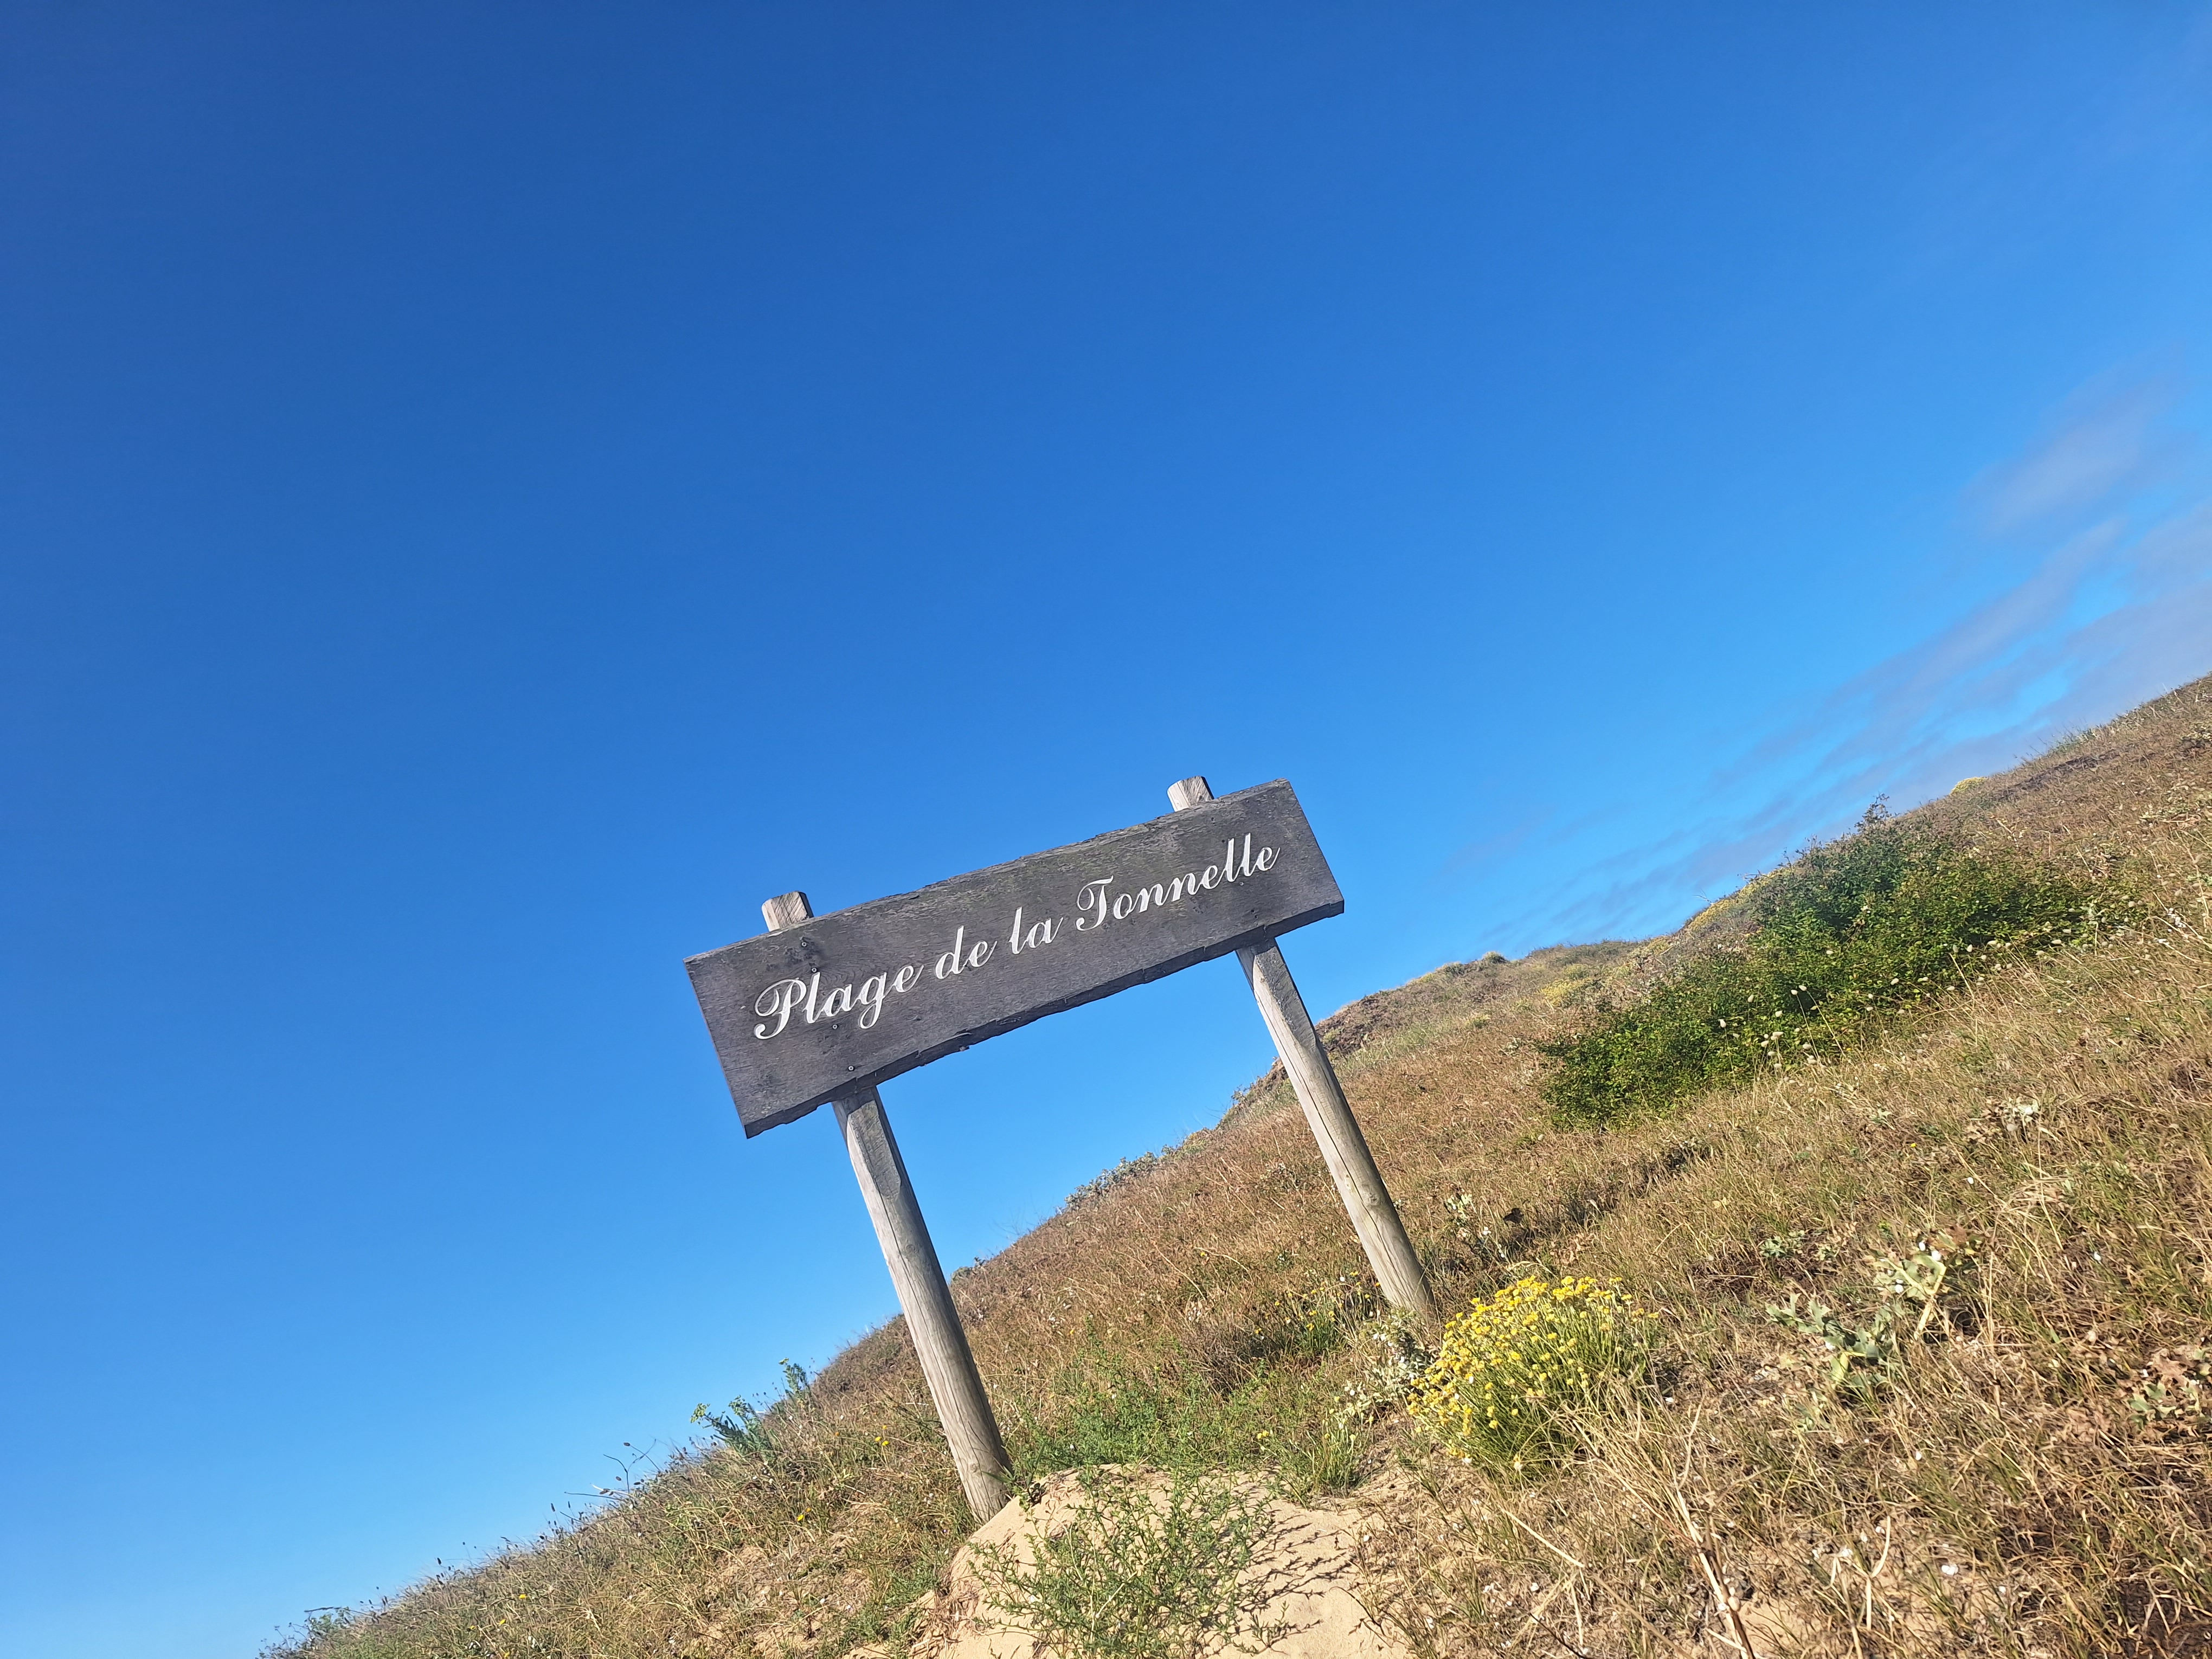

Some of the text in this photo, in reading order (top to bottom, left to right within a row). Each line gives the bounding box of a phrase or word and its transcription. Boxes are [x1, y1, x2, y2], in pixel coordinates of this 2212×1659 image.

[754, 832, 1281, 1040] Plage de la Tonnelle
